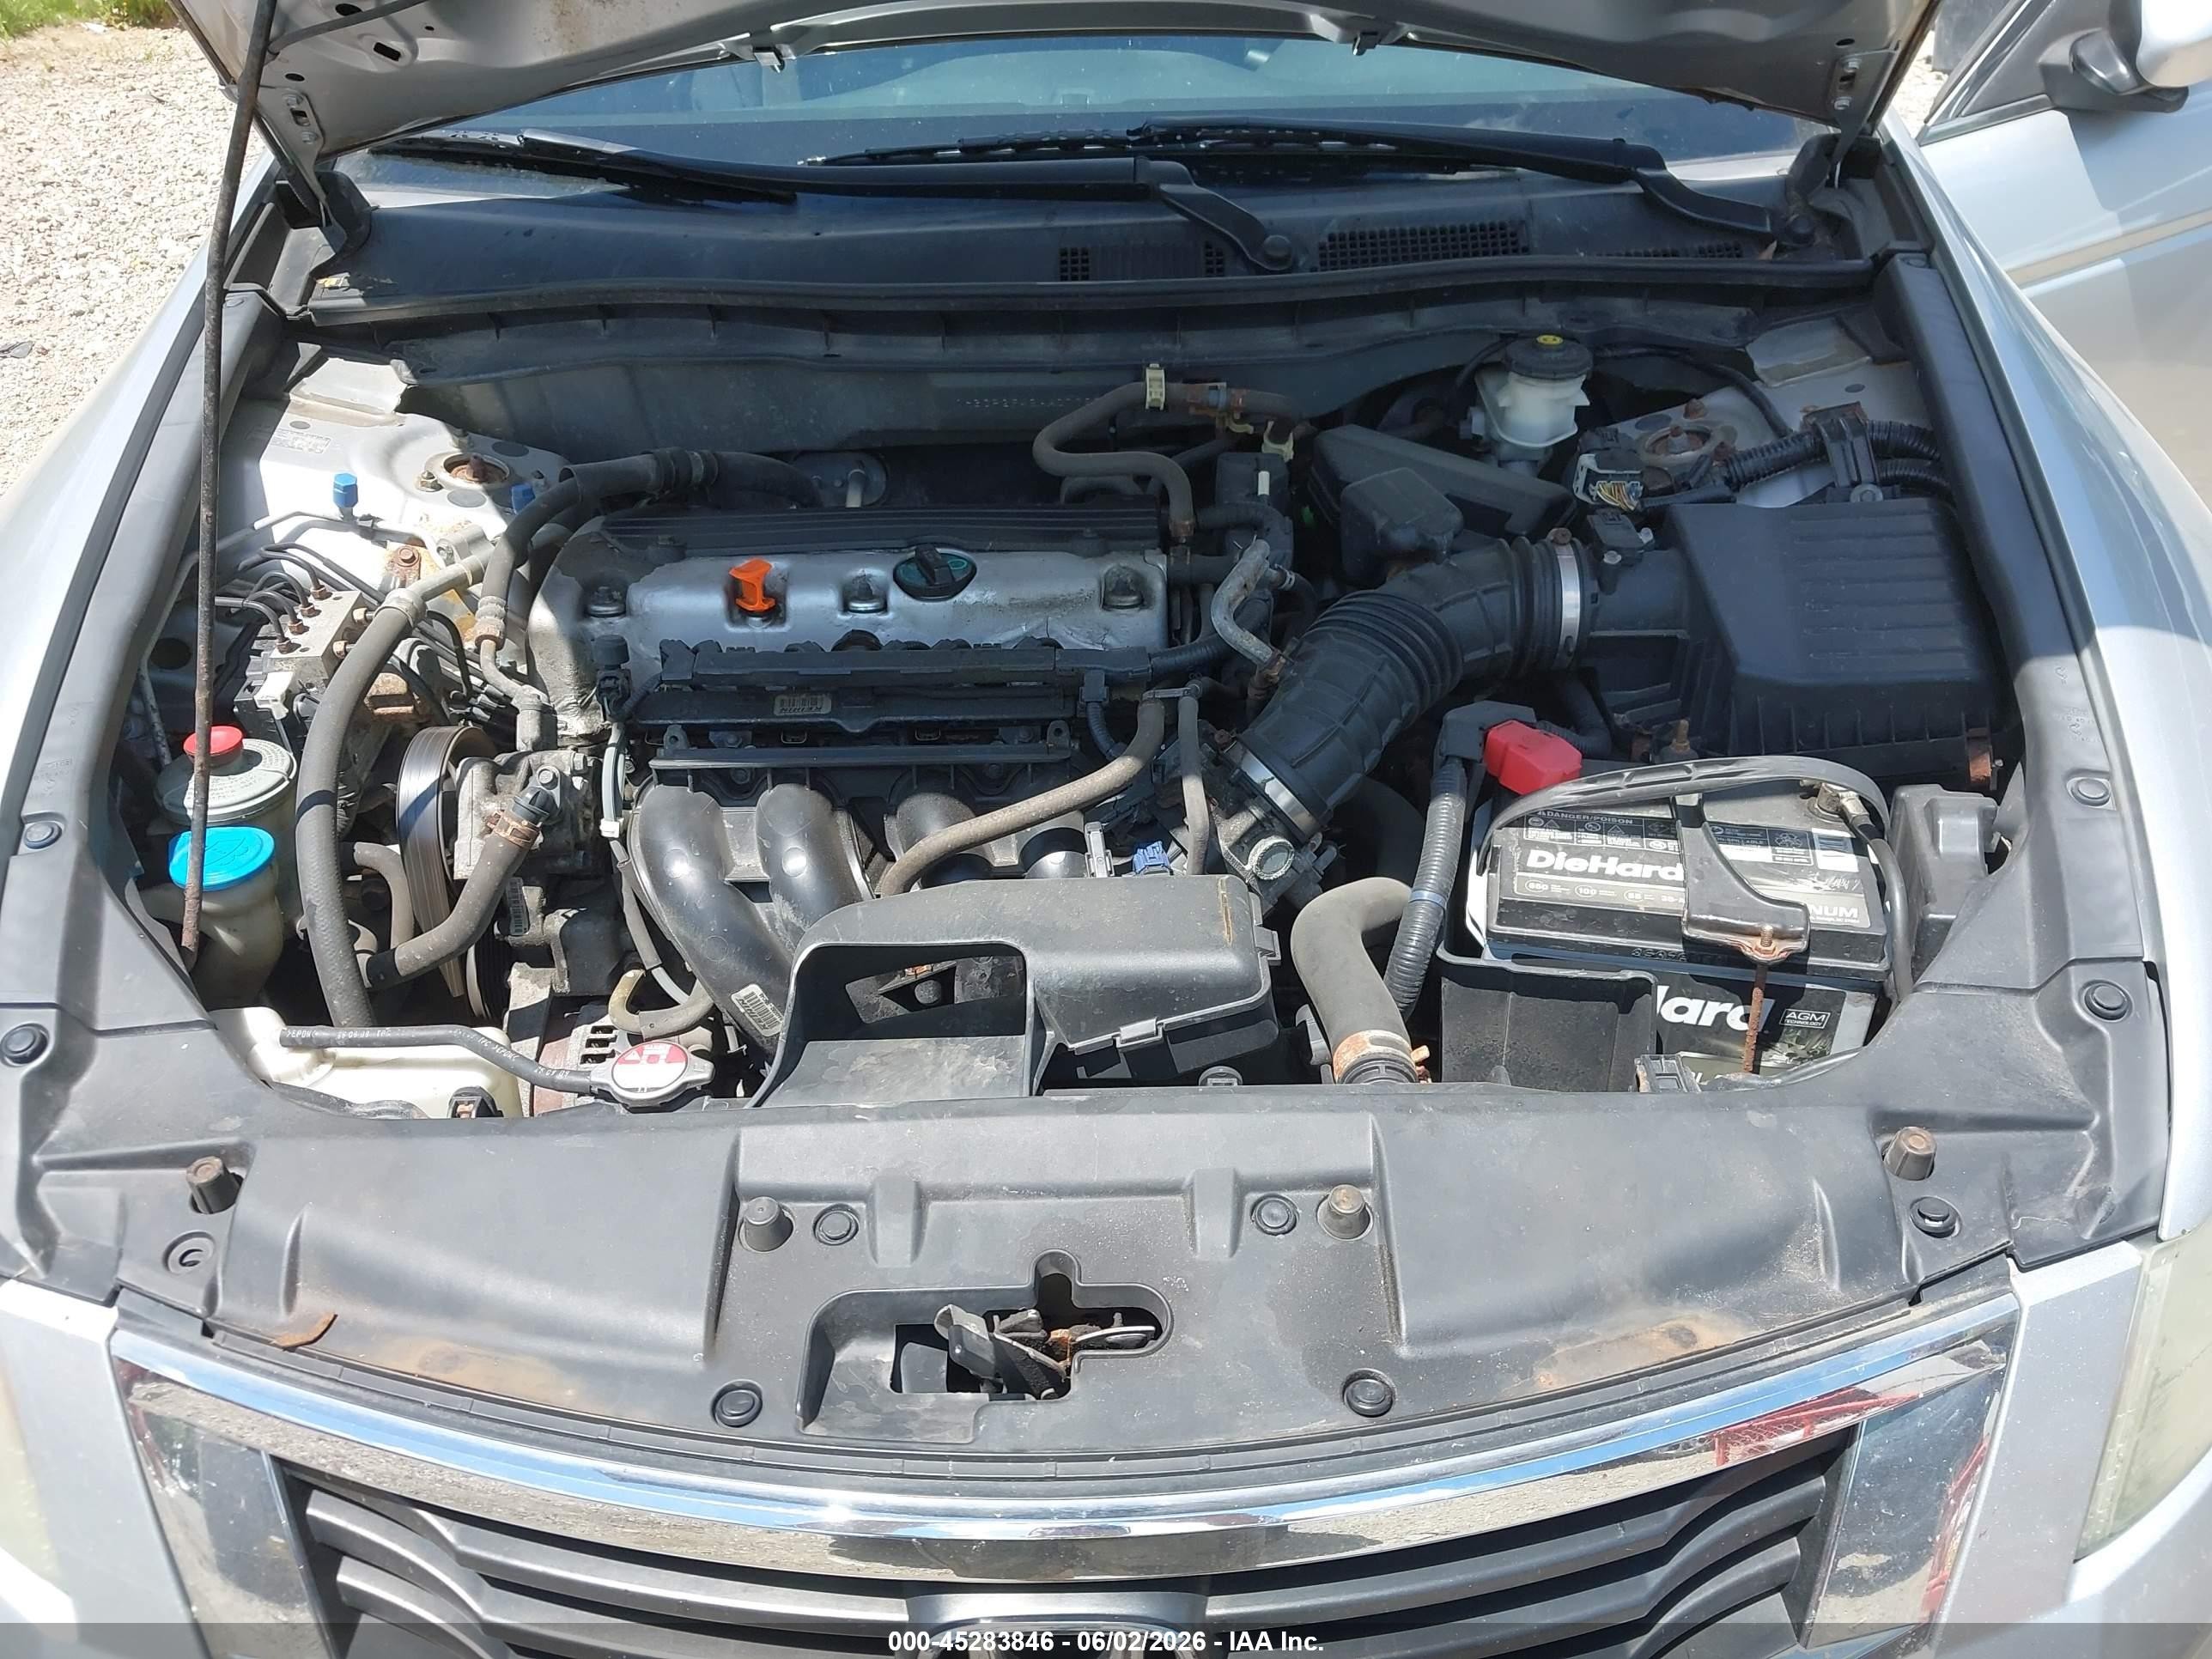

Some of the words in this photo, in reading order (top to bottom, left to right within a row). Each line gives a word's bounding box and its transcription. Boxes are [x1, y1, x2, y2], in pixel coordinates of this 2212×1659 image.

[1547, 811, 1633, 825] DANGER/POISON
[1527, 849, 1685, 882] DieHard
[1809, 906, 1858, 918] NUM
[1785, 1011, 1826, 1022] AGM
